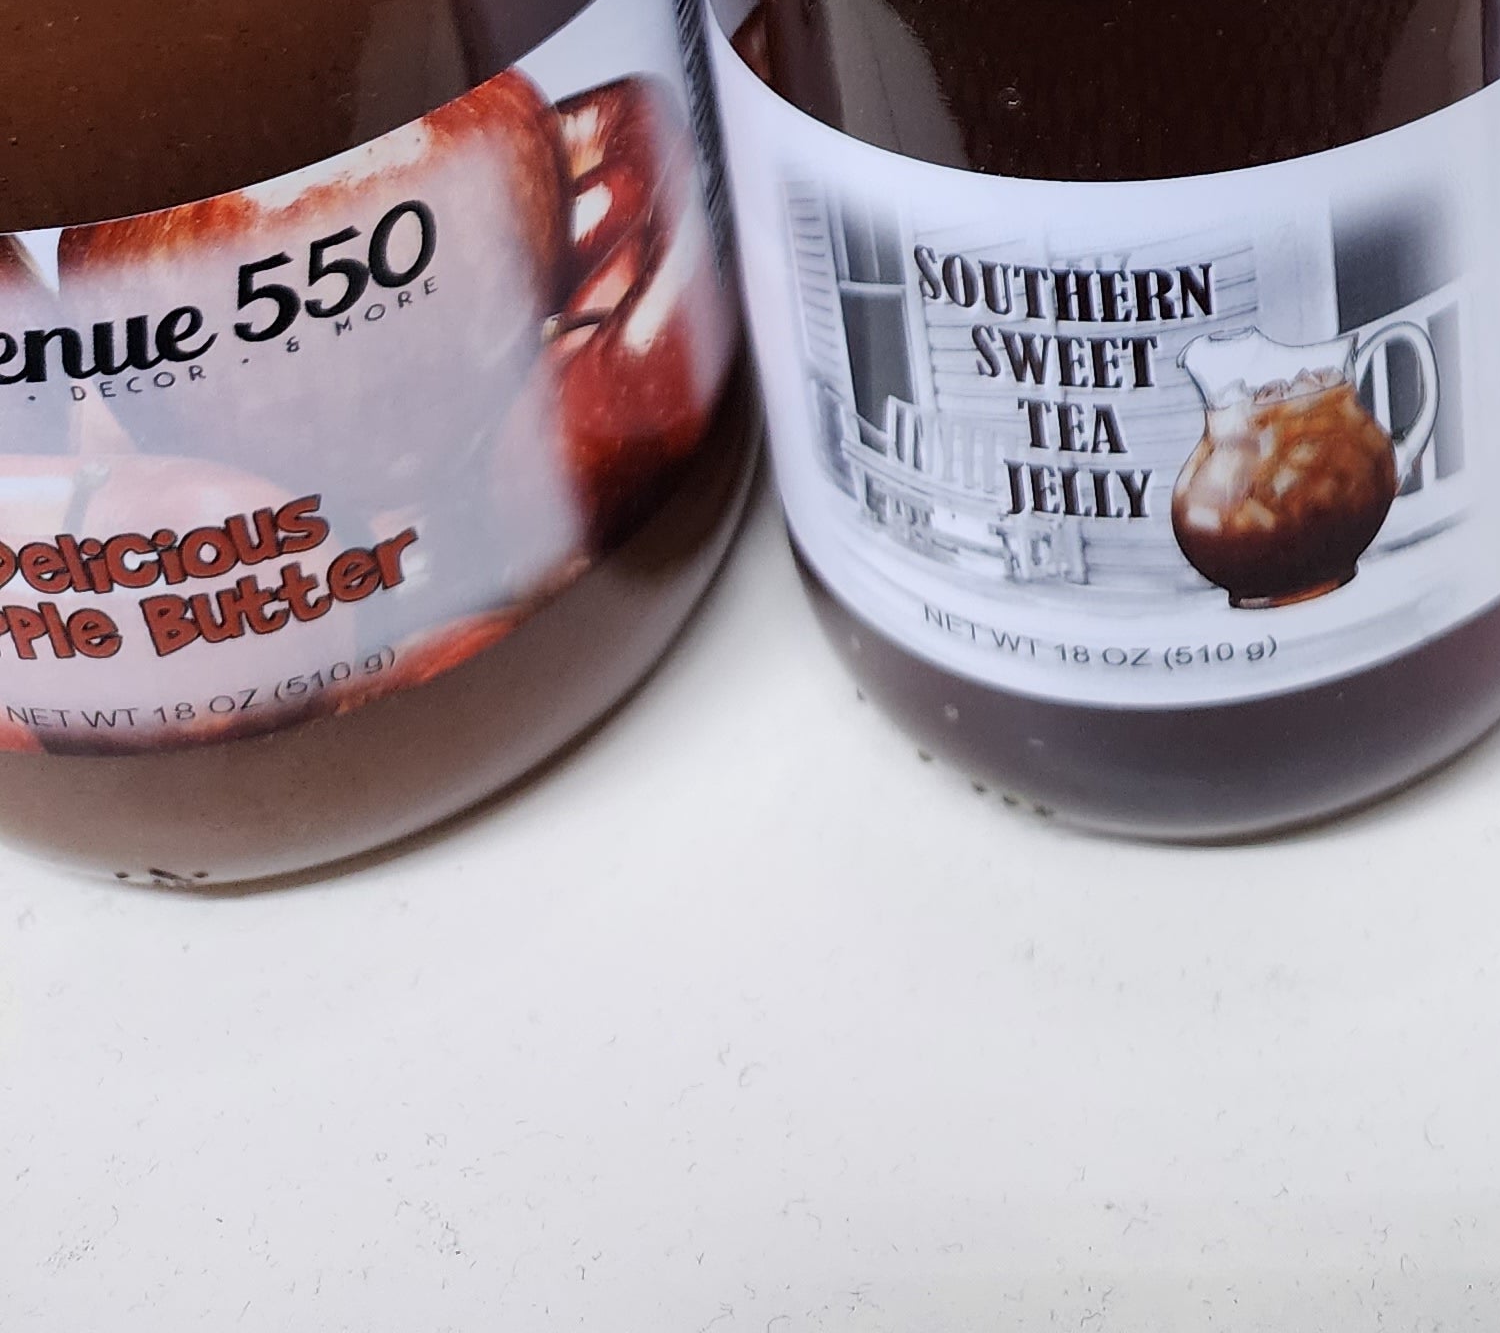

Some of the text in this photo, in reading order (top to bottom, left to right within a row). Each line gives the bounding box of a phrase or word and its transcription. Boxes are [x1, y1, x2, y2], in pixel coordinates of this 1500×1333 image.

[233, 199, 438, 343] 550
[913, 243, 1215, 323] SOUTHERN
[70, 364, 207, 402] DECOR
[334, 275, 438, 336] MORE
[971, 325, 1159, 389] SWEET
[1017, 396, 1129, 454] TEA
[1002, 458, 1154, 519] JELLY
[138, 526, 419, 658] Butter
[923, 603, 1279, 671] NET WT 18 OZ (510 g)
[6, 704, 71, 728] NET
[80, 707, 139, 729] WT
[153, 701, 196, 725] 18
[208, 688, 260, 715] OZ
[273, 661, 352, 703] (510
